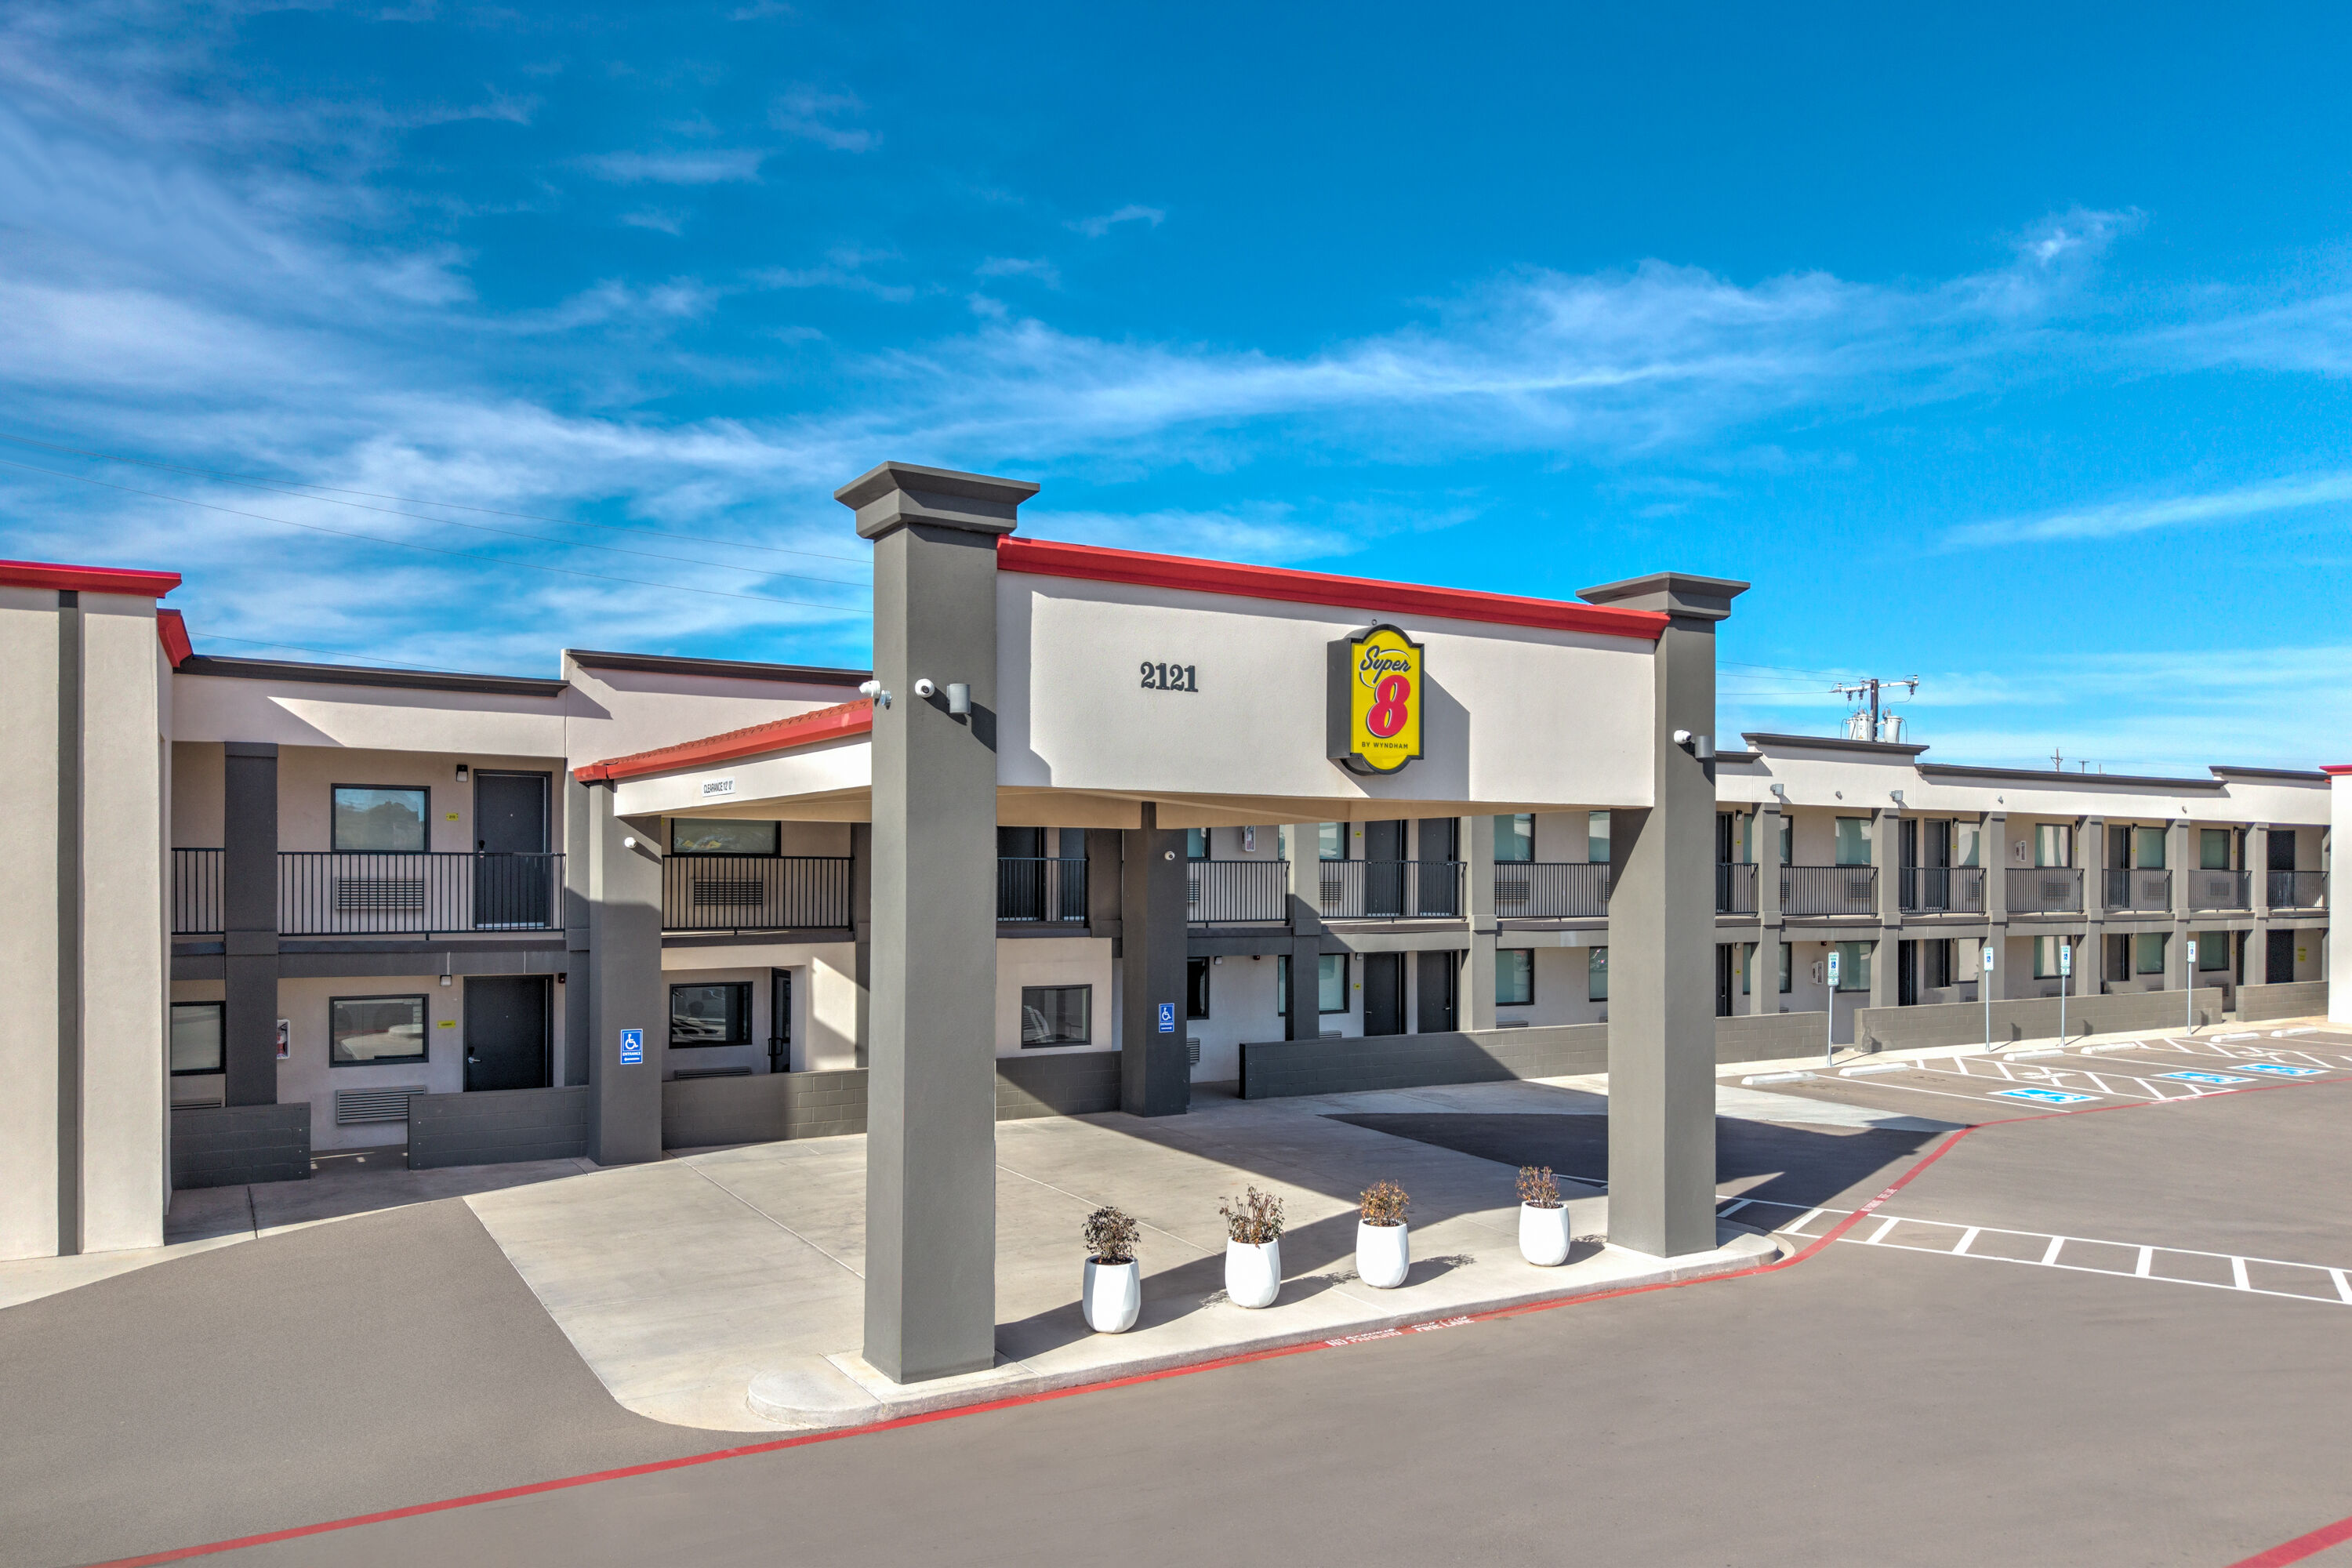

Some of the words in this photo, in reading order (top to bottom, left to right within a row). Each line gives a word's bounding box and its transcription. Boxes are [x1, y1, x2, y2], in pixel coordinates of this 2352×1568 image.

[1140, 661, 1199, 692] 2121
[1359, 644, 1411, 684] Super
[1366, 675, 1410, 739] 8
[1373, 741, 1408, 750] WYNDHAM
[704, 782, 723, 793] CLEARANCE
